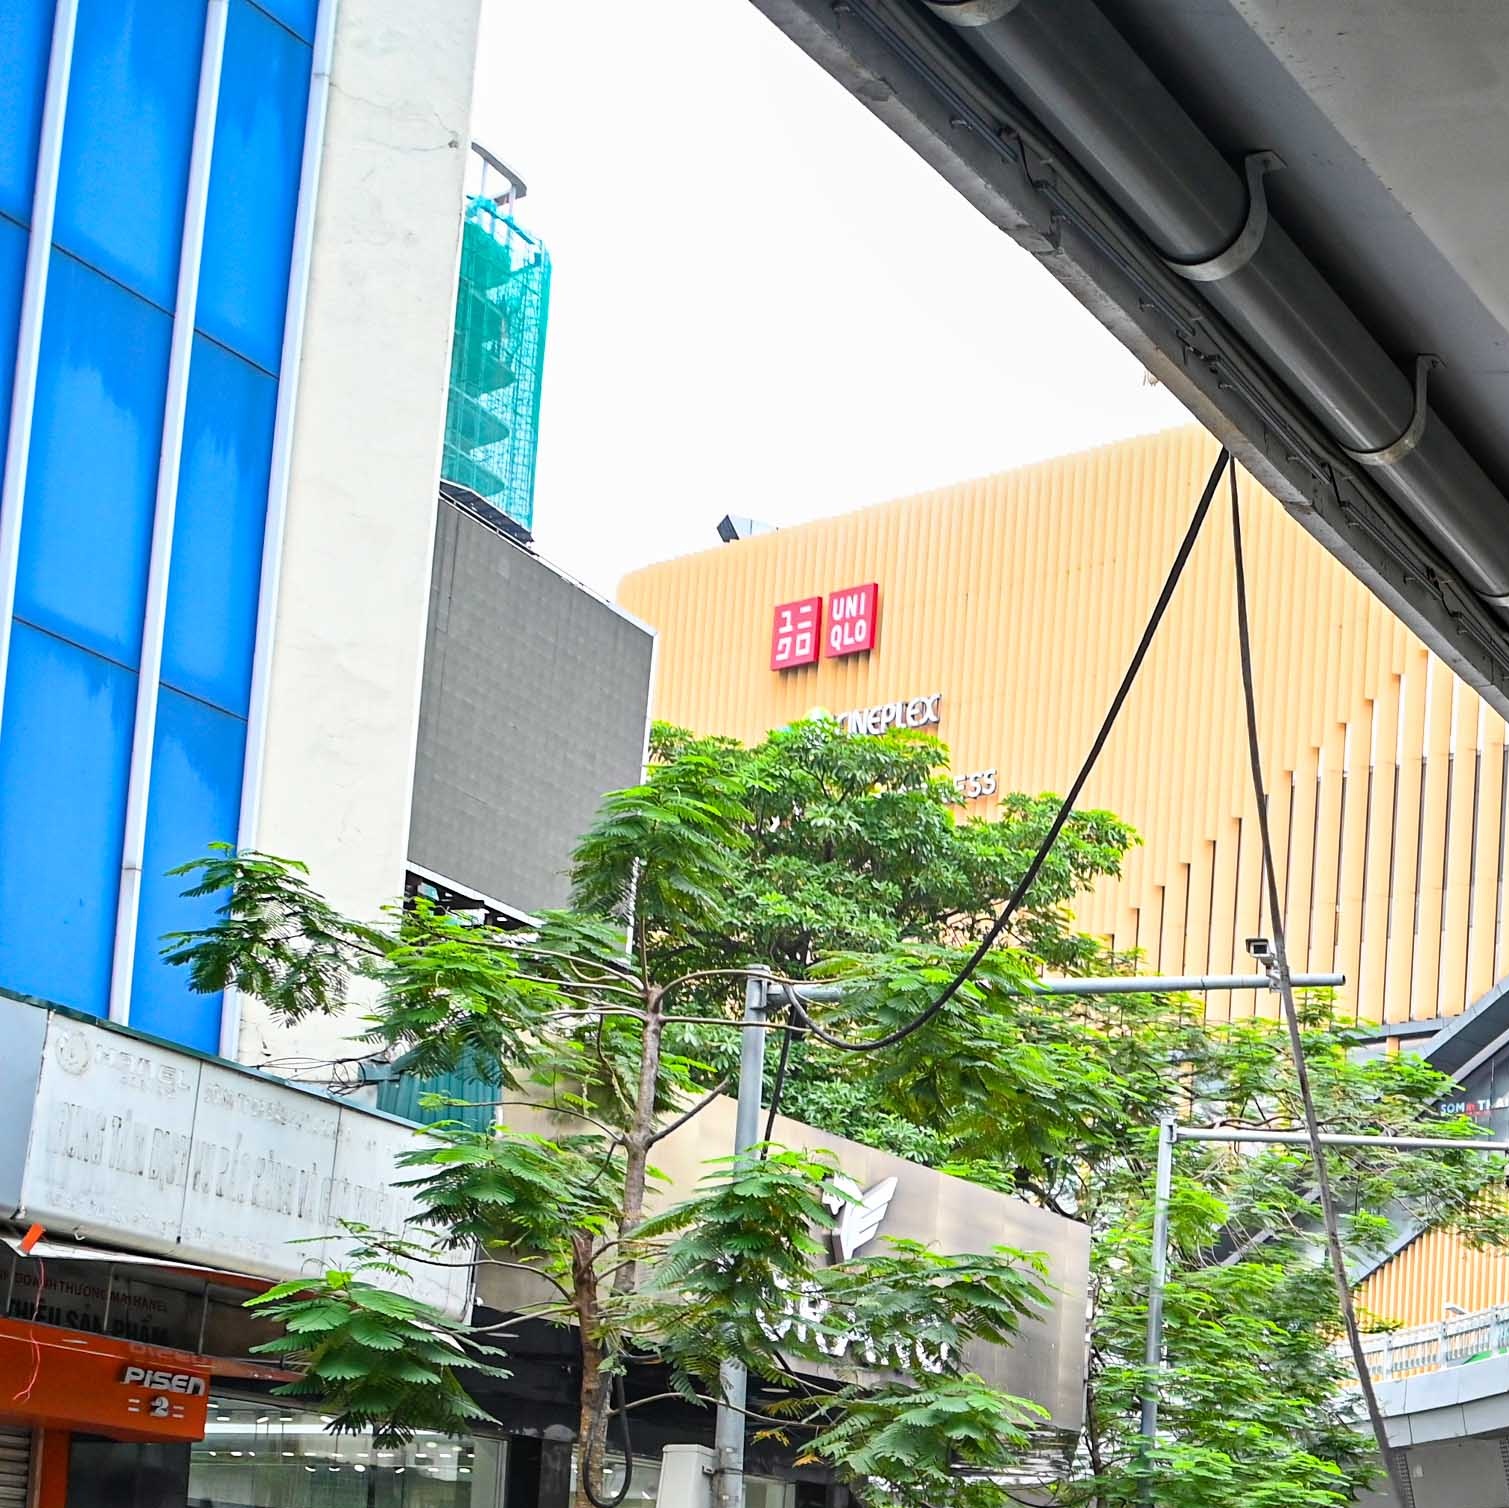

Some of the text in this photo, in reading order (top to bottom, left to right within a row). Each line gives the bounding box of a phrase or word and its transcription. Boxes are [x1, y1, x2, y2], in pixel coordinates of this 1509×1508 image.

[832, 592, 866, 621] UNI
[830, 618, 867, 650] QLO
[836, 693, 942, 735] CINEPLEX
[123, 1366, 206, 1396] PISEN
[150, 1396, 169, 1418] 2
